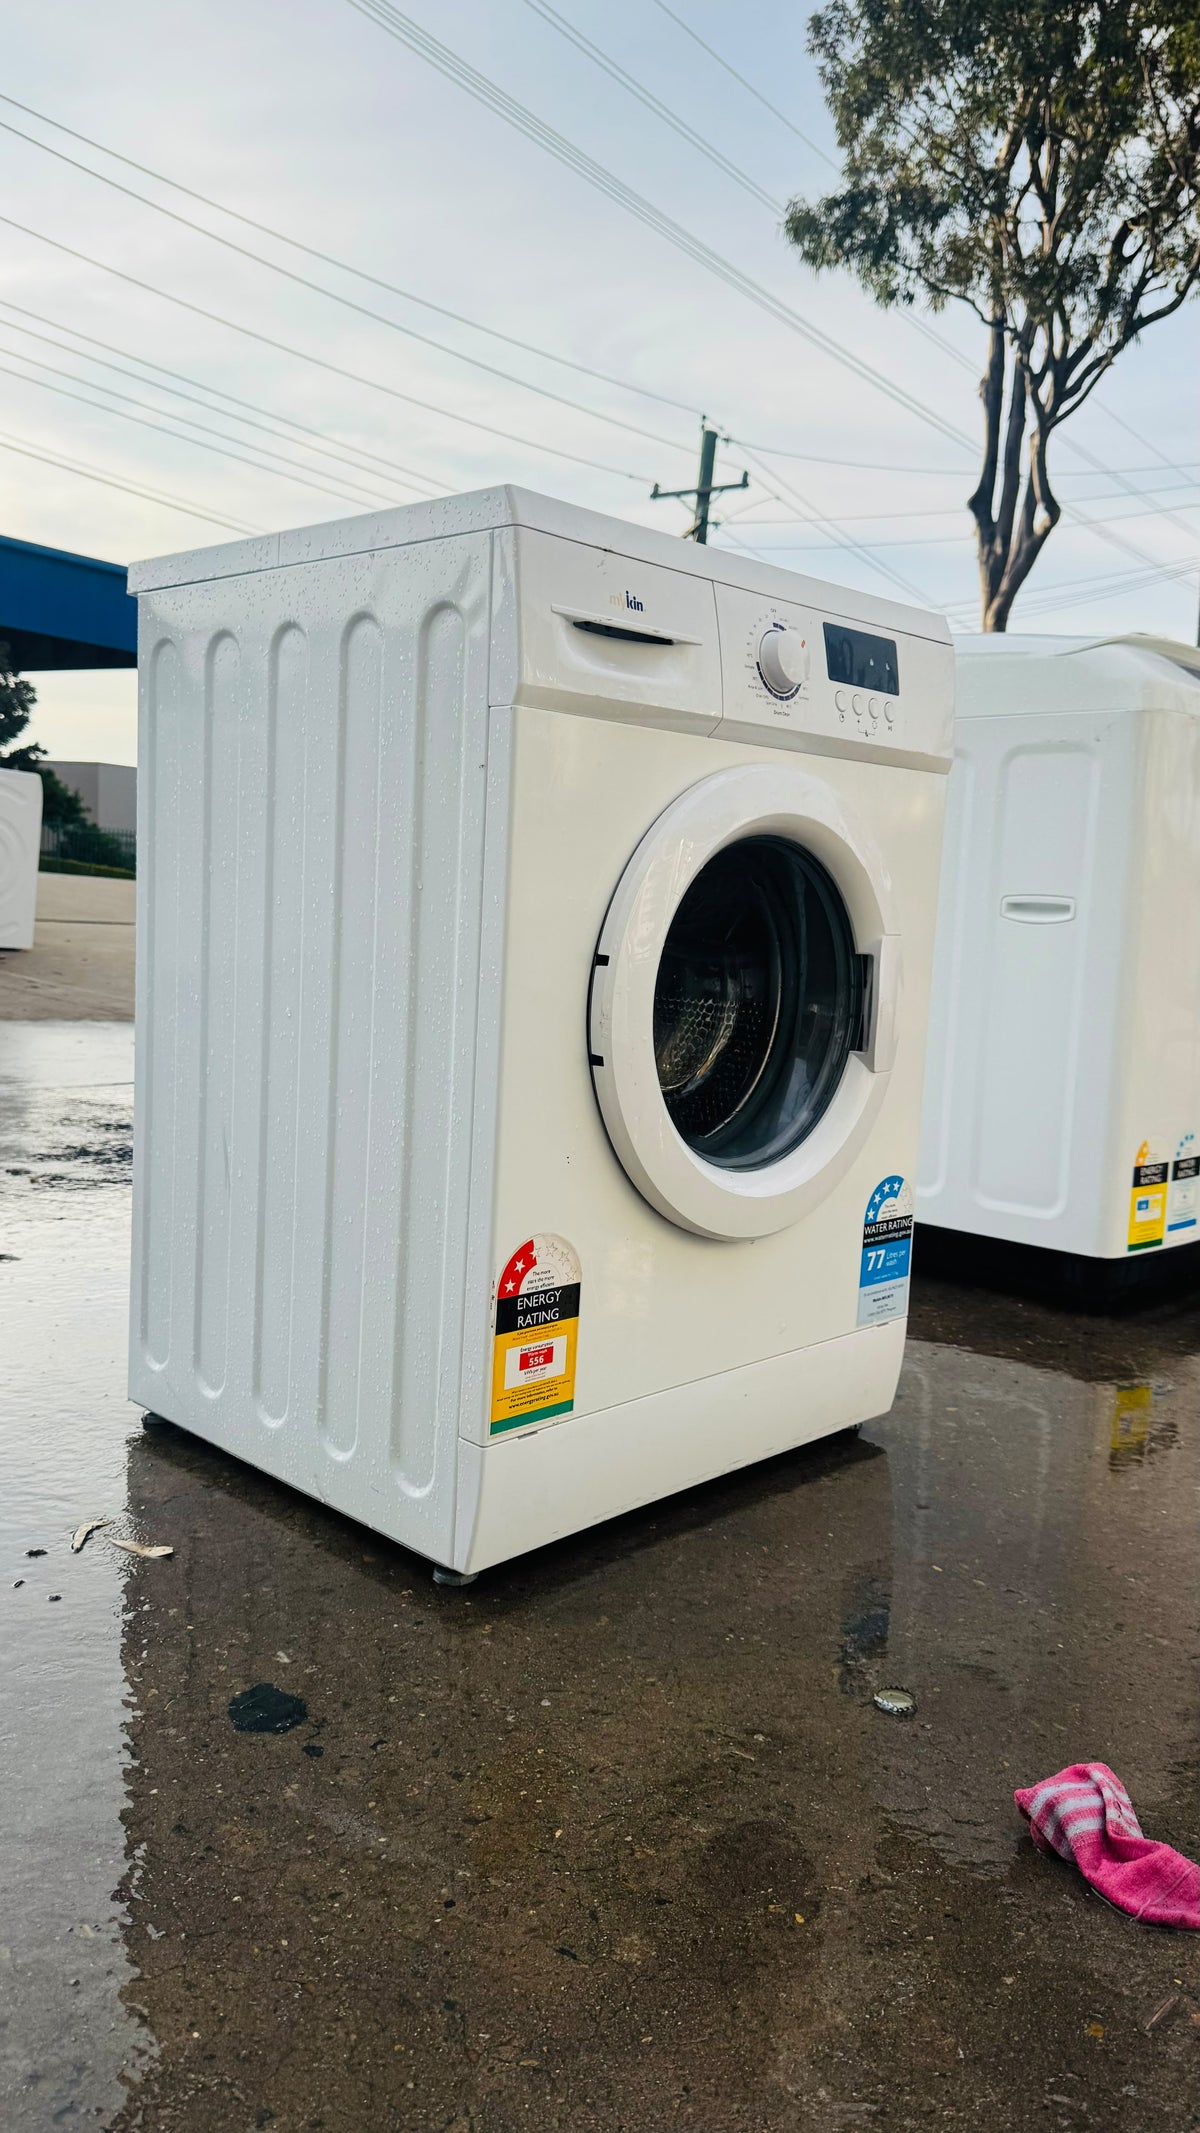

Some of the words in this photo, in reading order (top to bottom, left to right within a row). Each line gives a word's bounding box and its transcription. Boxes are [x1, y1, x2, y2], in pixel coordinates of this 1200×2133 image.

[864, 1222, 888, 1235] WATER
[888, 1217, 913, 1230] RATING
[867, 1249, 886, 1271] 77
[517, 1289, 562, 1310] ENERGY
[517, 1308, 560, 1328] RATING
[528, 1355, 545, 1367] 556
